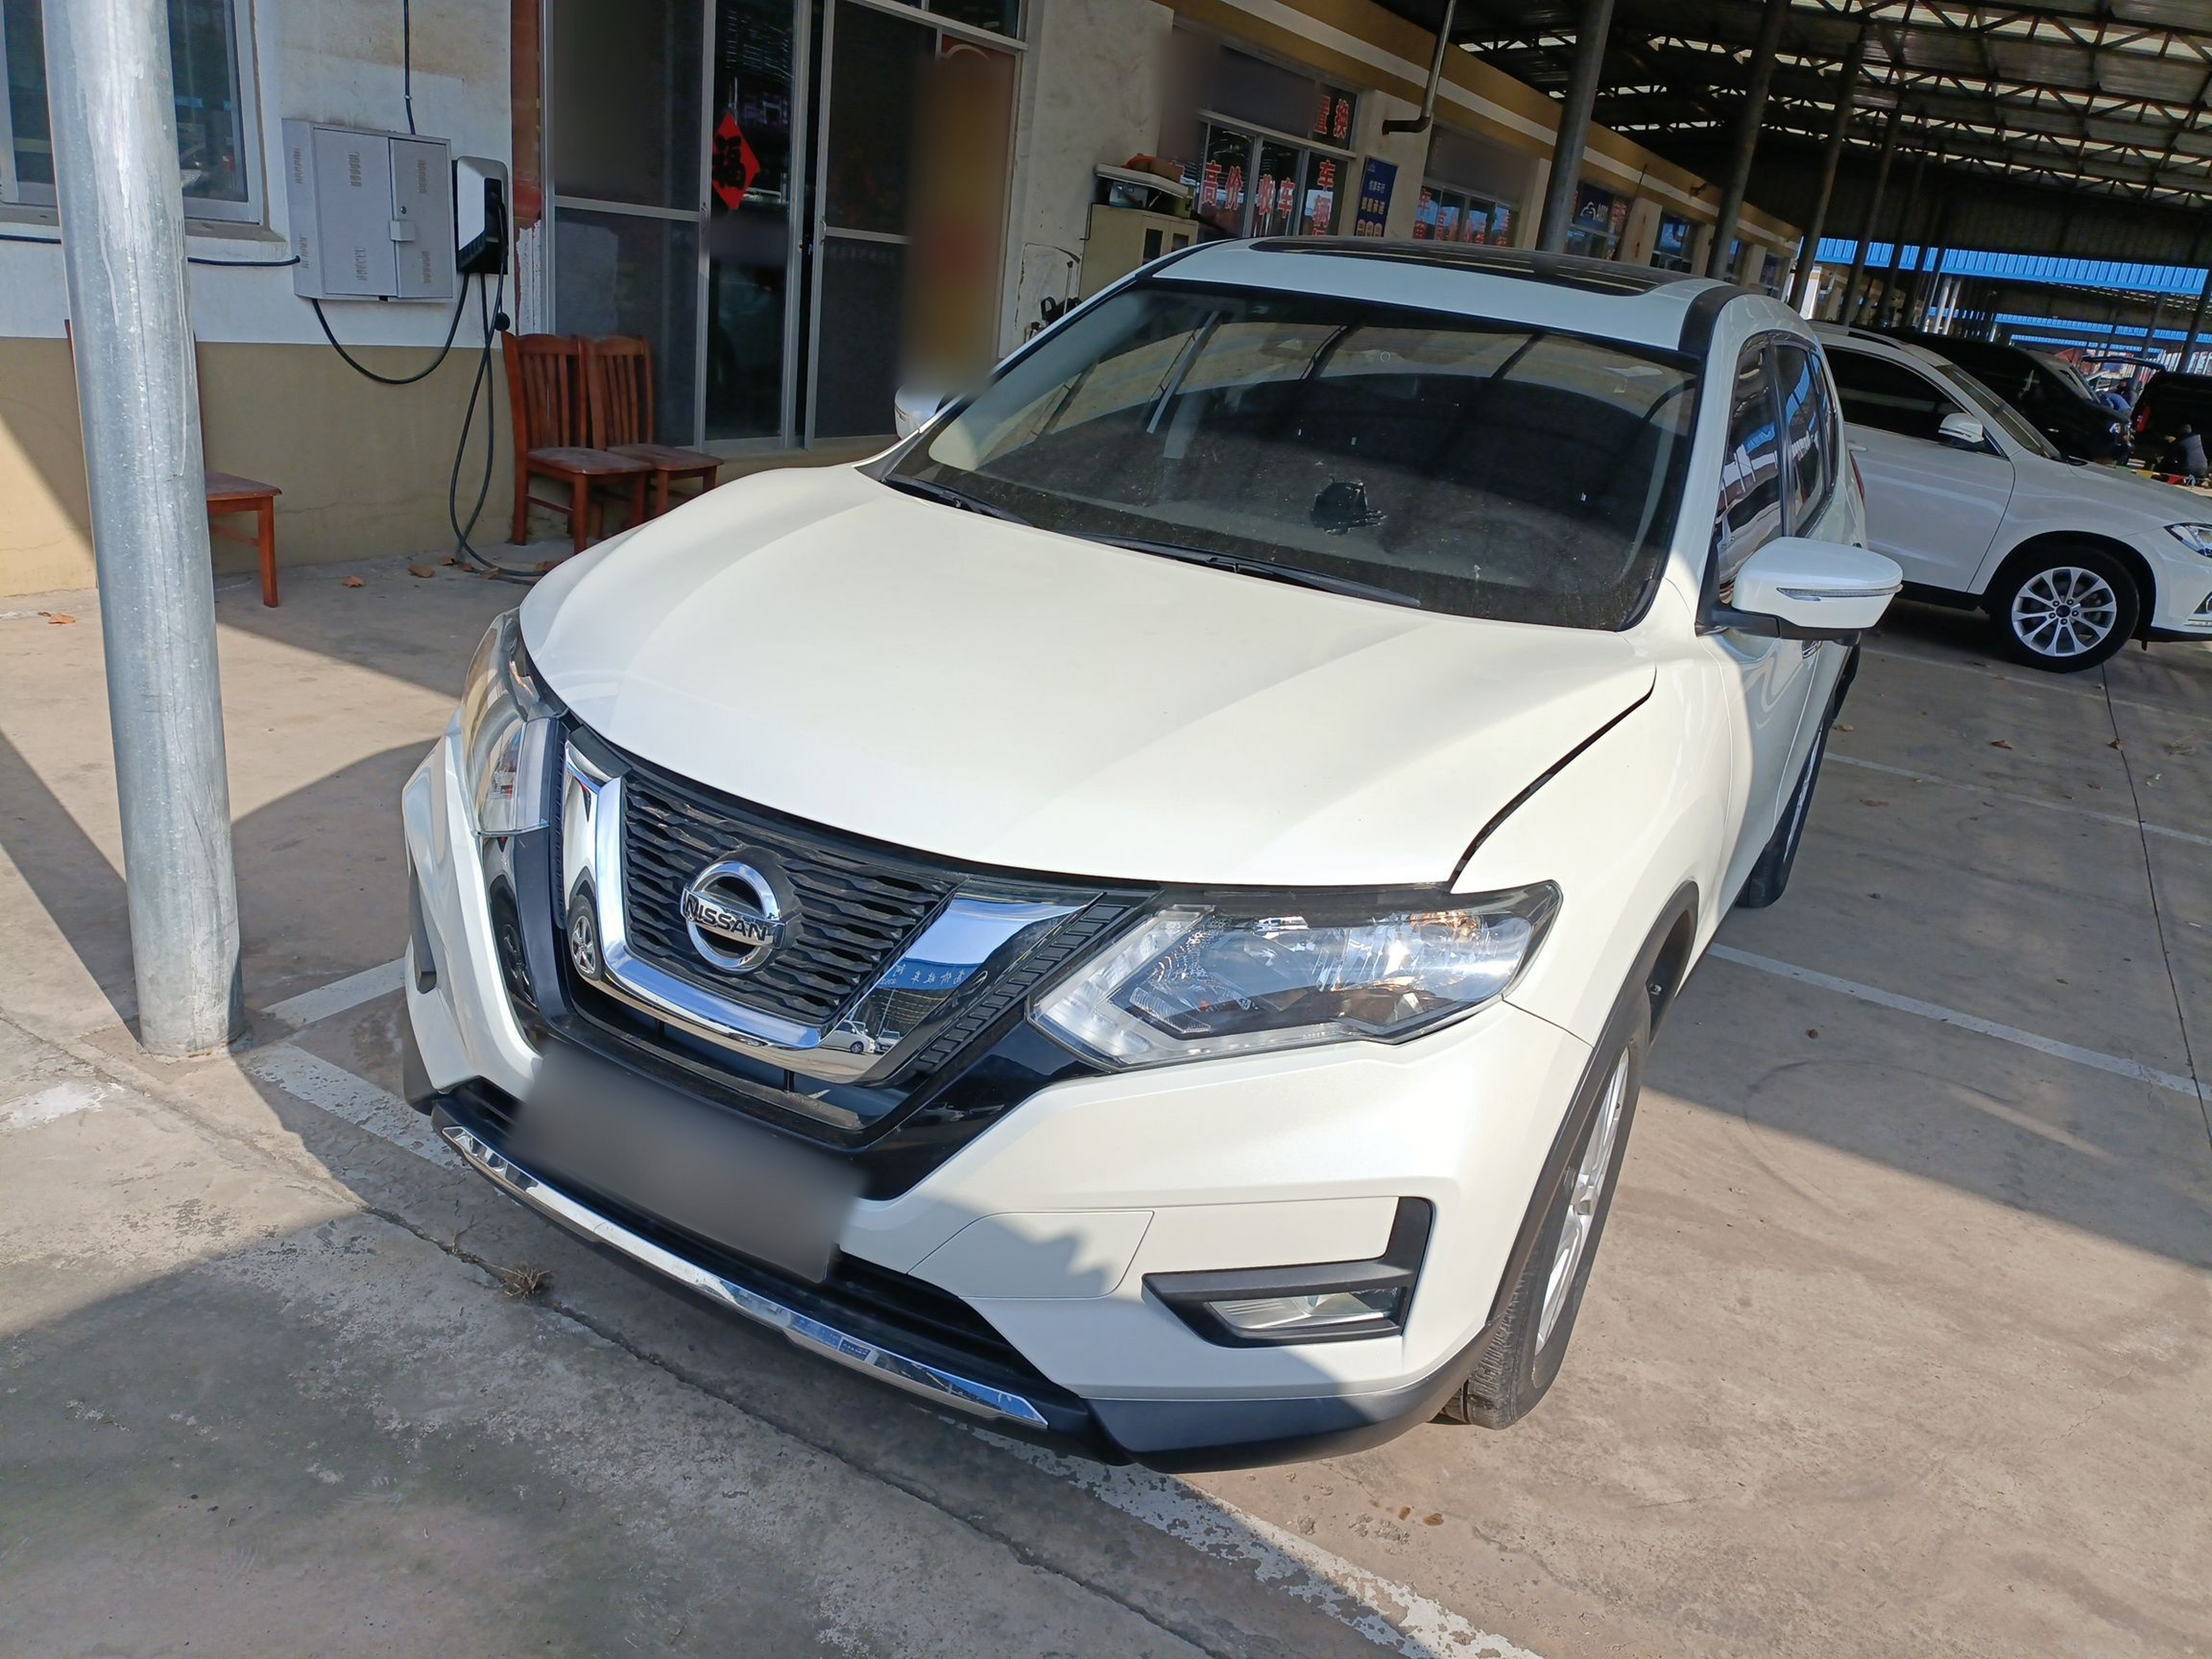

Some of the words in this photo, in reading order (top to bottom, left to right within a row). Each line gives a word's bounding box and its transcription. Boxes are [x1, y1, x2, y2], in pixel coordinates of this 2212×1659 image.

[1202, 160, 1295, 218] 高价收车
[684, 892, 767, 941] NISSAN
